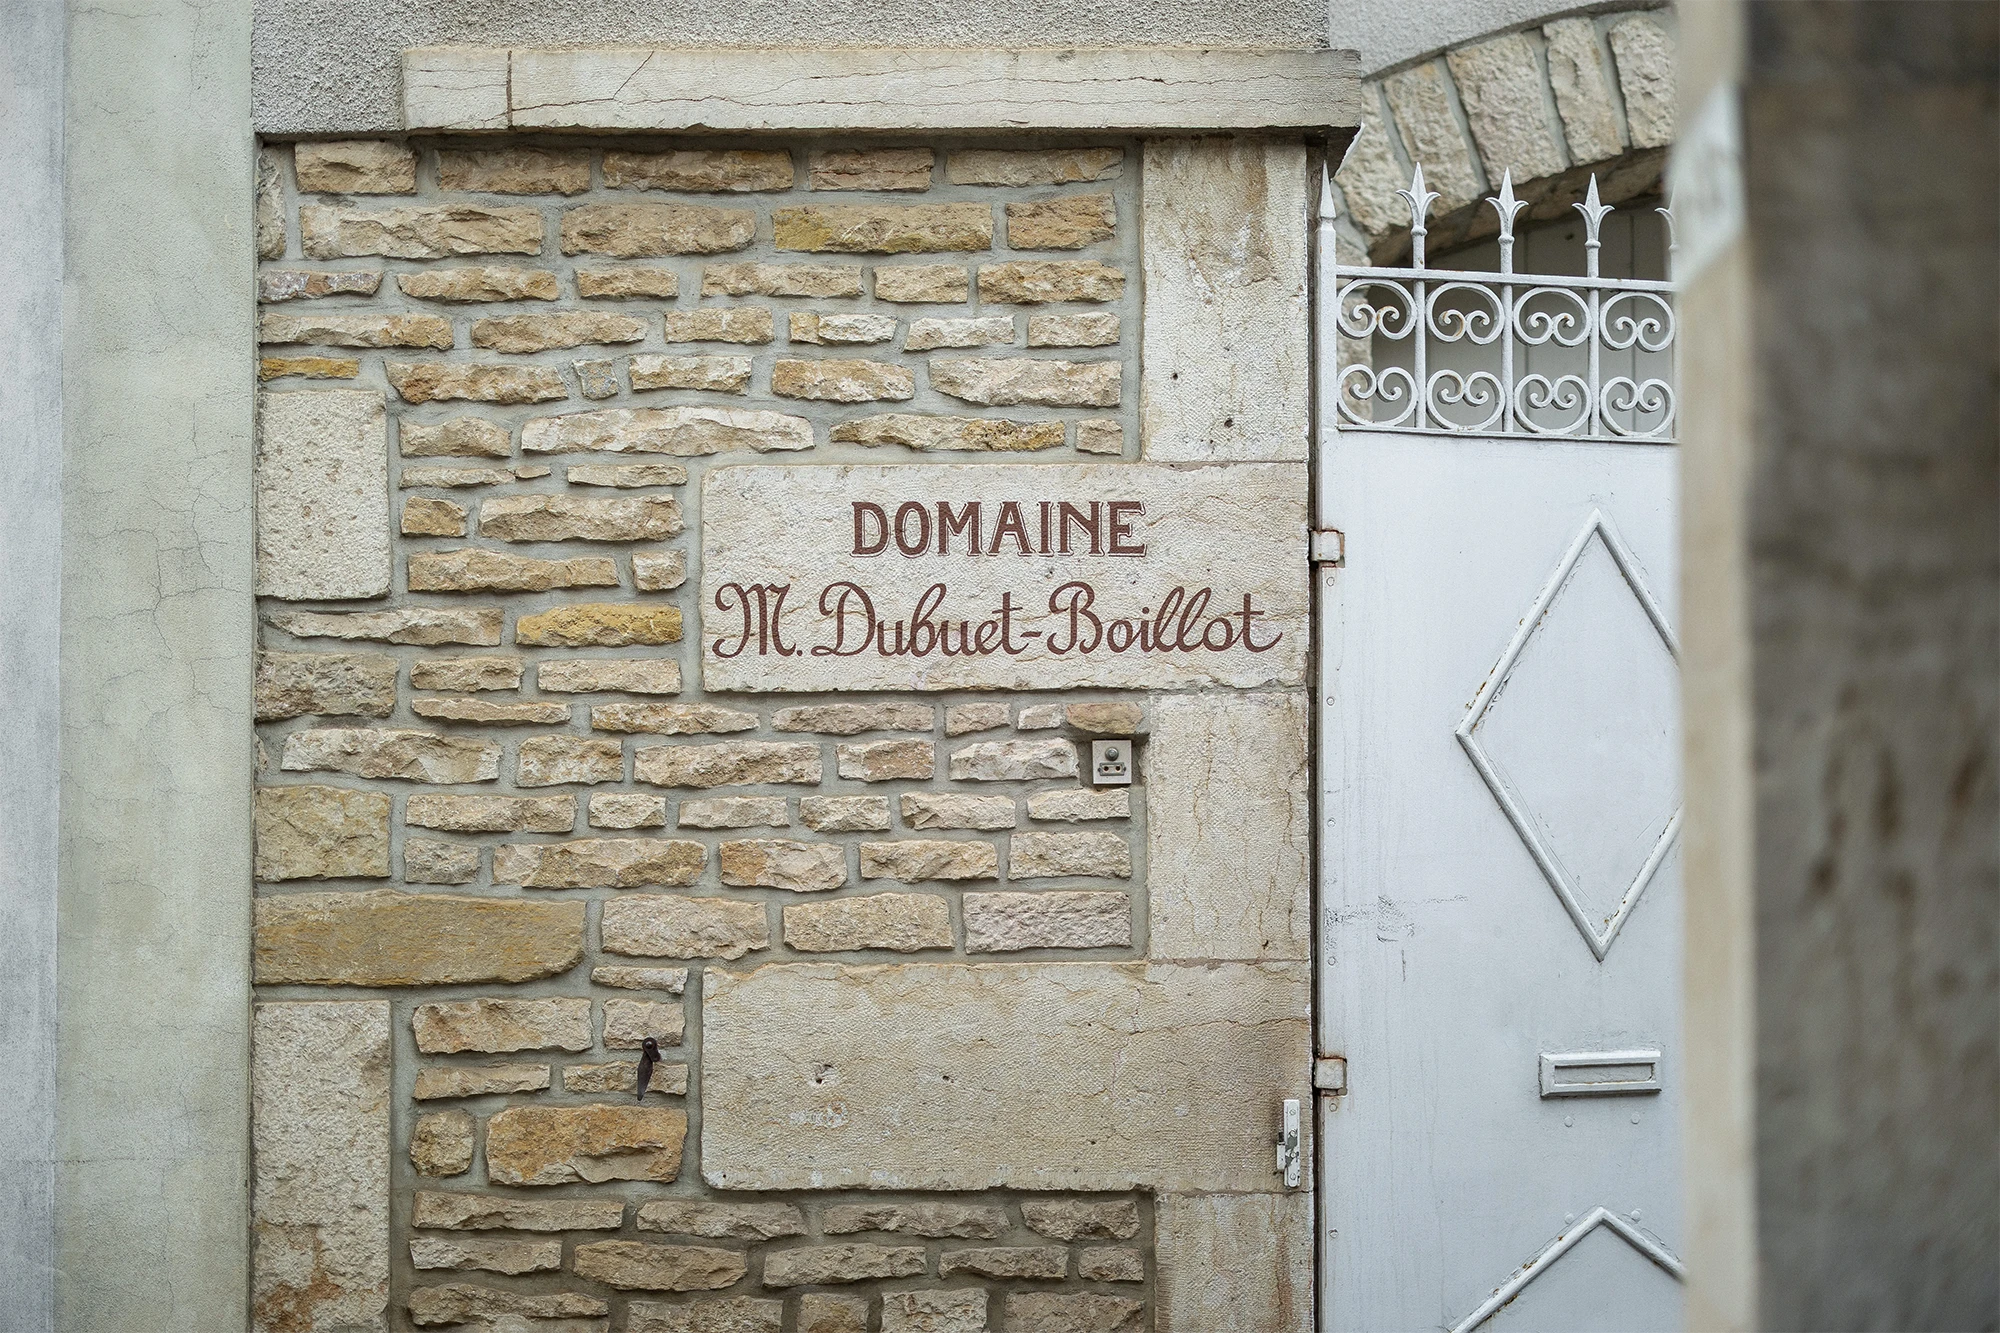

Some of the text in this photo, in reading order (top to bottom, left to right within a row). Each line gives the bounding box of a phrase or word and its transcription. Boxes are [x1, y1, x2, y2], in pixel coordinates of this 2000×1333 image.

[850, 501, 1148, 558] DOMAINE
[712, 581, 1283, 658] M. Dubuet-Boillot
